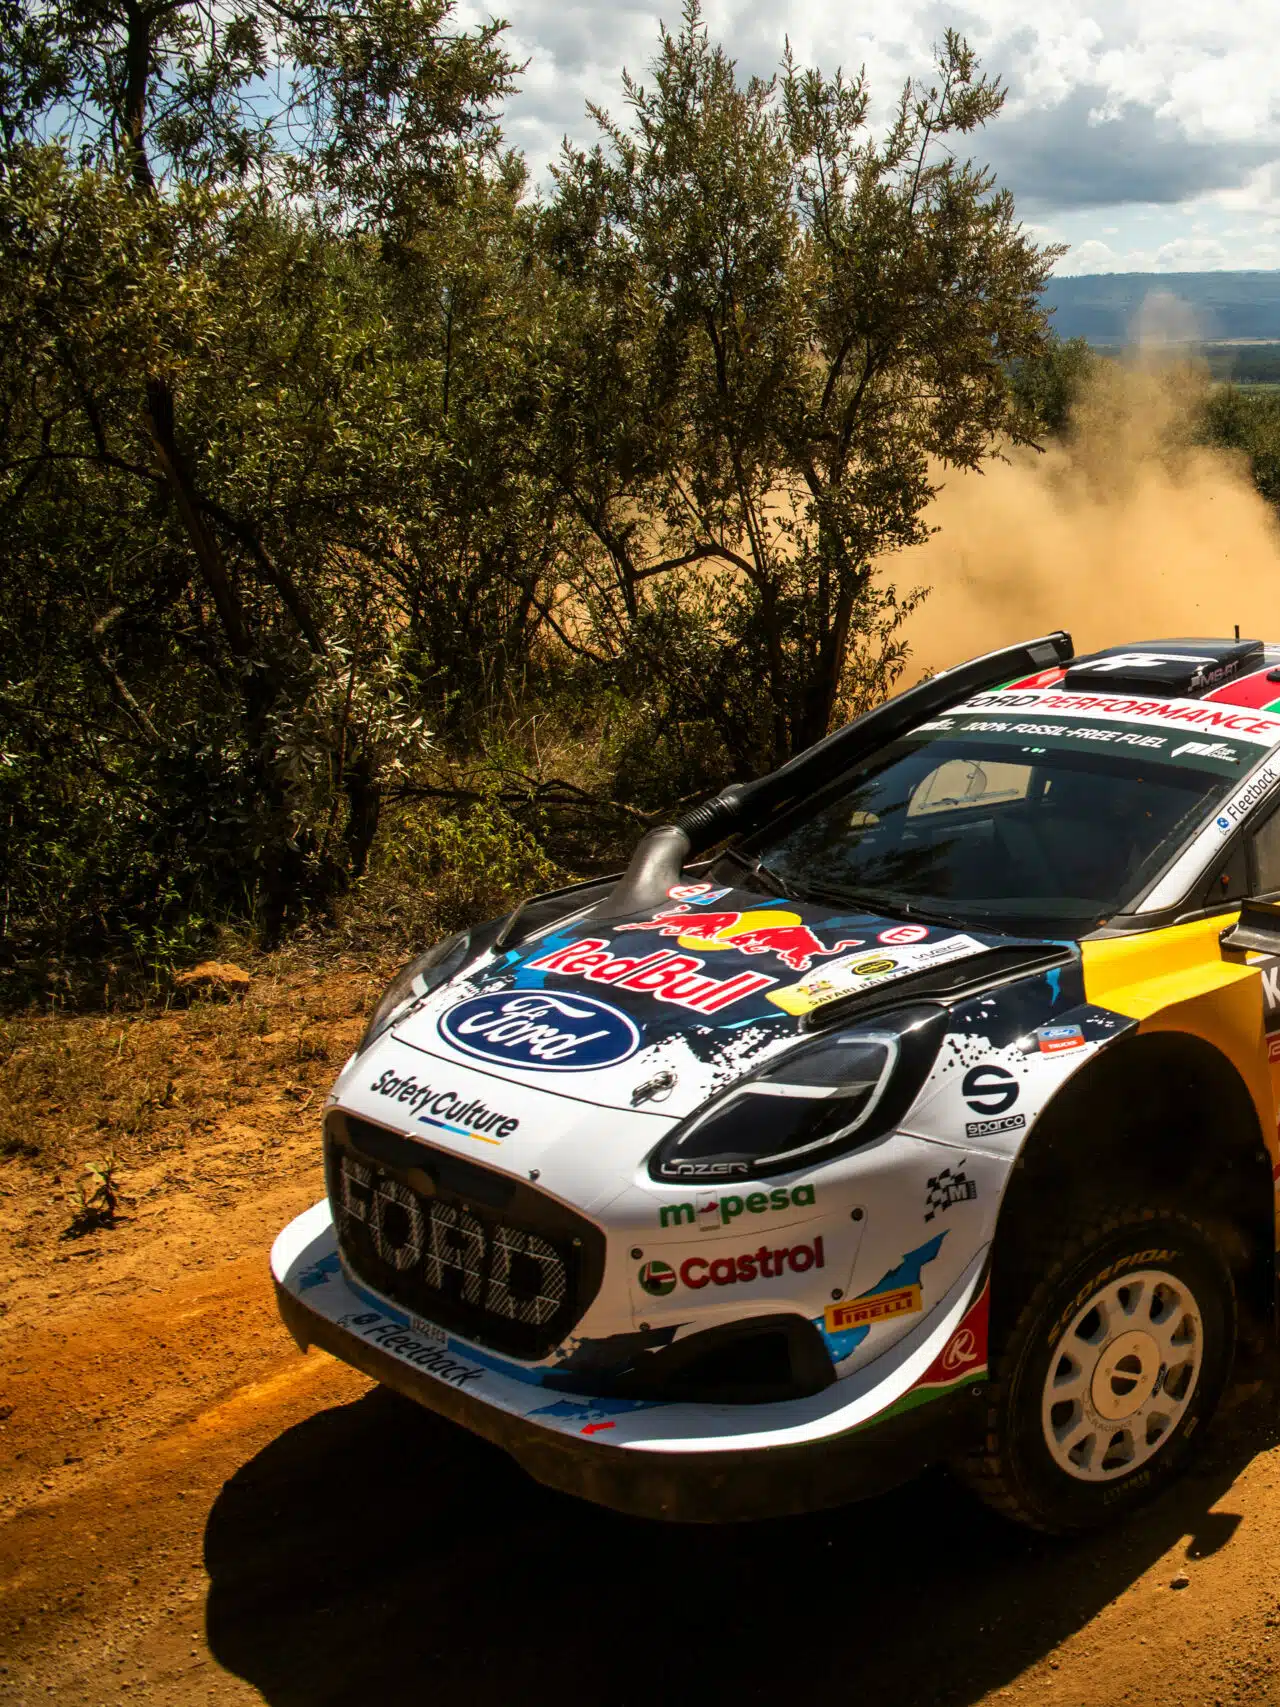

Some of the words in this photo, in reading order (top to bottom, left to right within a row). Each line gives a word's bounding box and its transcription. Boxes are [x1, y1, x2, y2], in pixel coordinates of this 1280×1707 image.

[960, 721, 1010, 733] 100%
[1006, 723, 1122, 742] FOSSIL-FREE
[1115, 733, 1168, 749] FUEL
[1227, 768, 1277, 821] Fleetback
[808, 987, 857, 1006] SAFARI
[859, 974, 898, 990] RALLY
[456, 996, 610, 1059] Ford
[370, 1068, 519, 1138] SafetyCulture
[967, 1114, 1024, 1136] sparco
[340, 1155, 568, 1326] FORD
[679, 1236, 824, 1290] Castrol
[832, 1288, 914, 1328] PIRELLI
[364, 1323, 487, 1387] Fleetback
